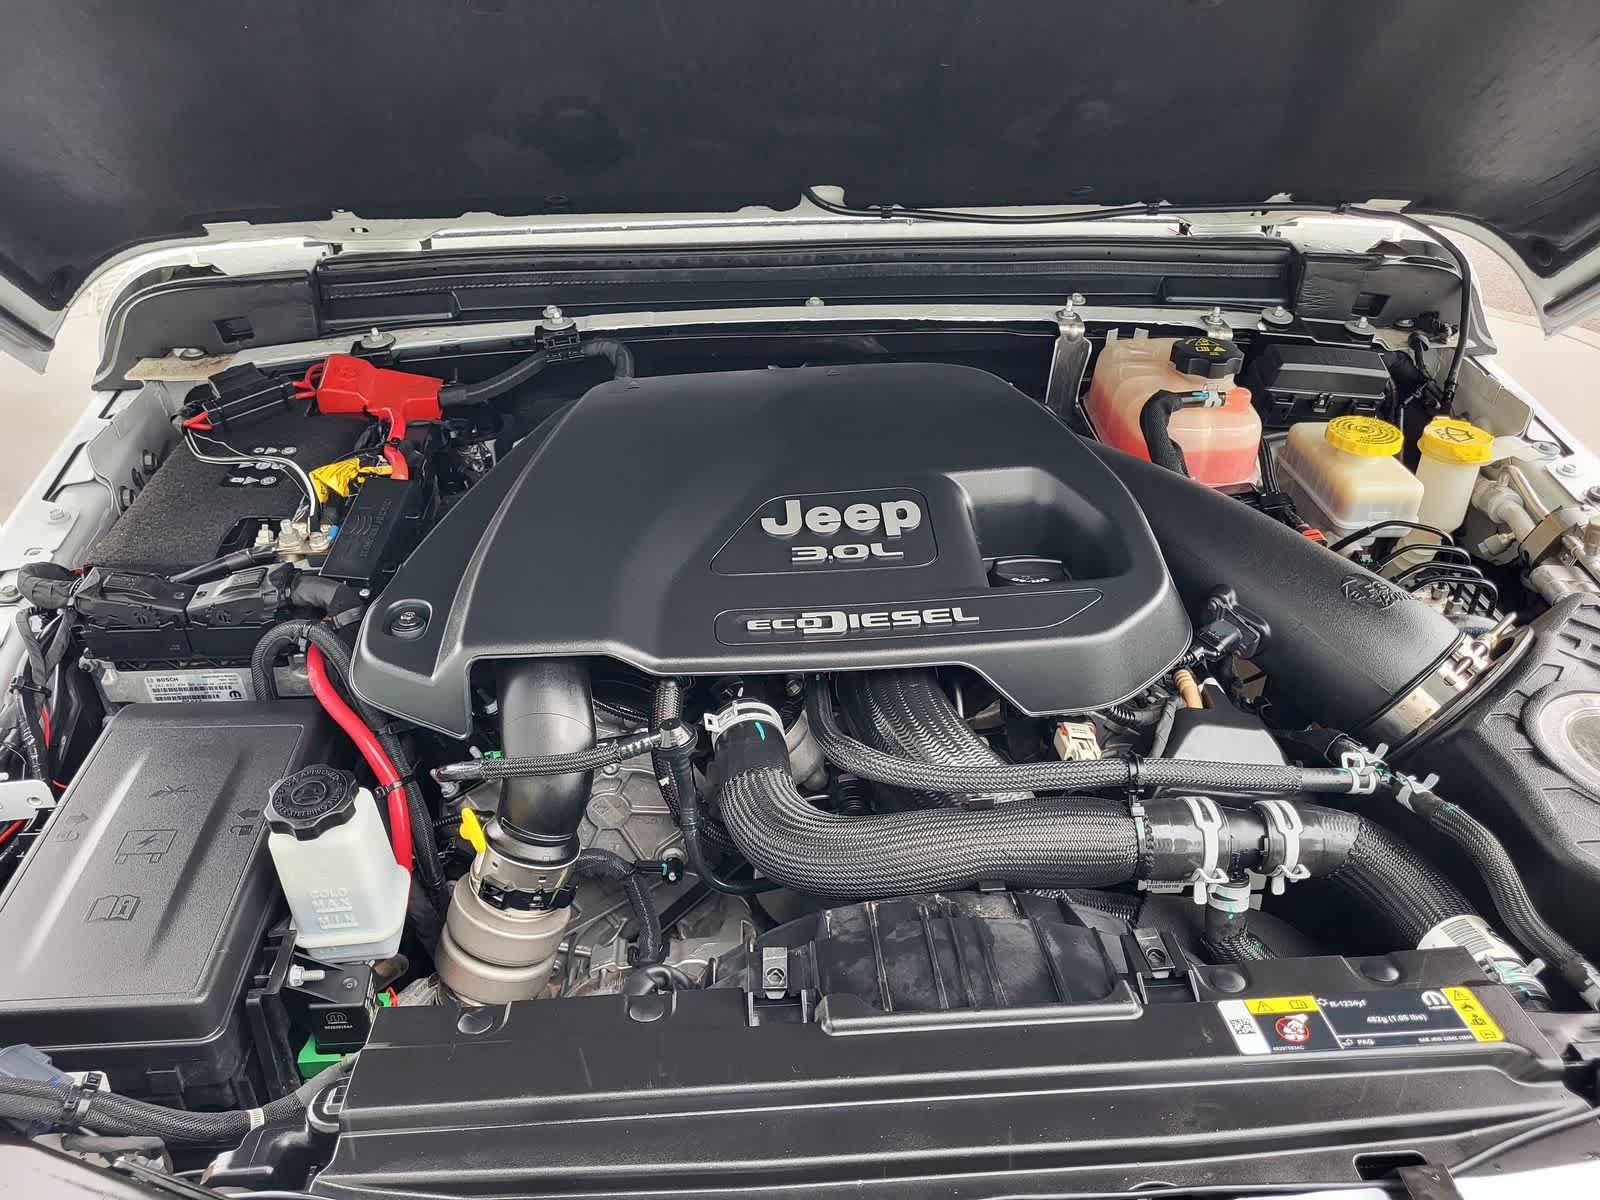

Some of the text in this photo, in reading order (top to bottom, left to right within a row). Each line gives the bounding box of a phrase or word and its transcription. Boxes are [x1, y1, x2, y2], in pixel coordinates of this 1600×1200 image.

[761, 499, 922, 538] Jeep
[791, 543, 904, 563] 3.0L
[312, 898, 351, 907] MAX
